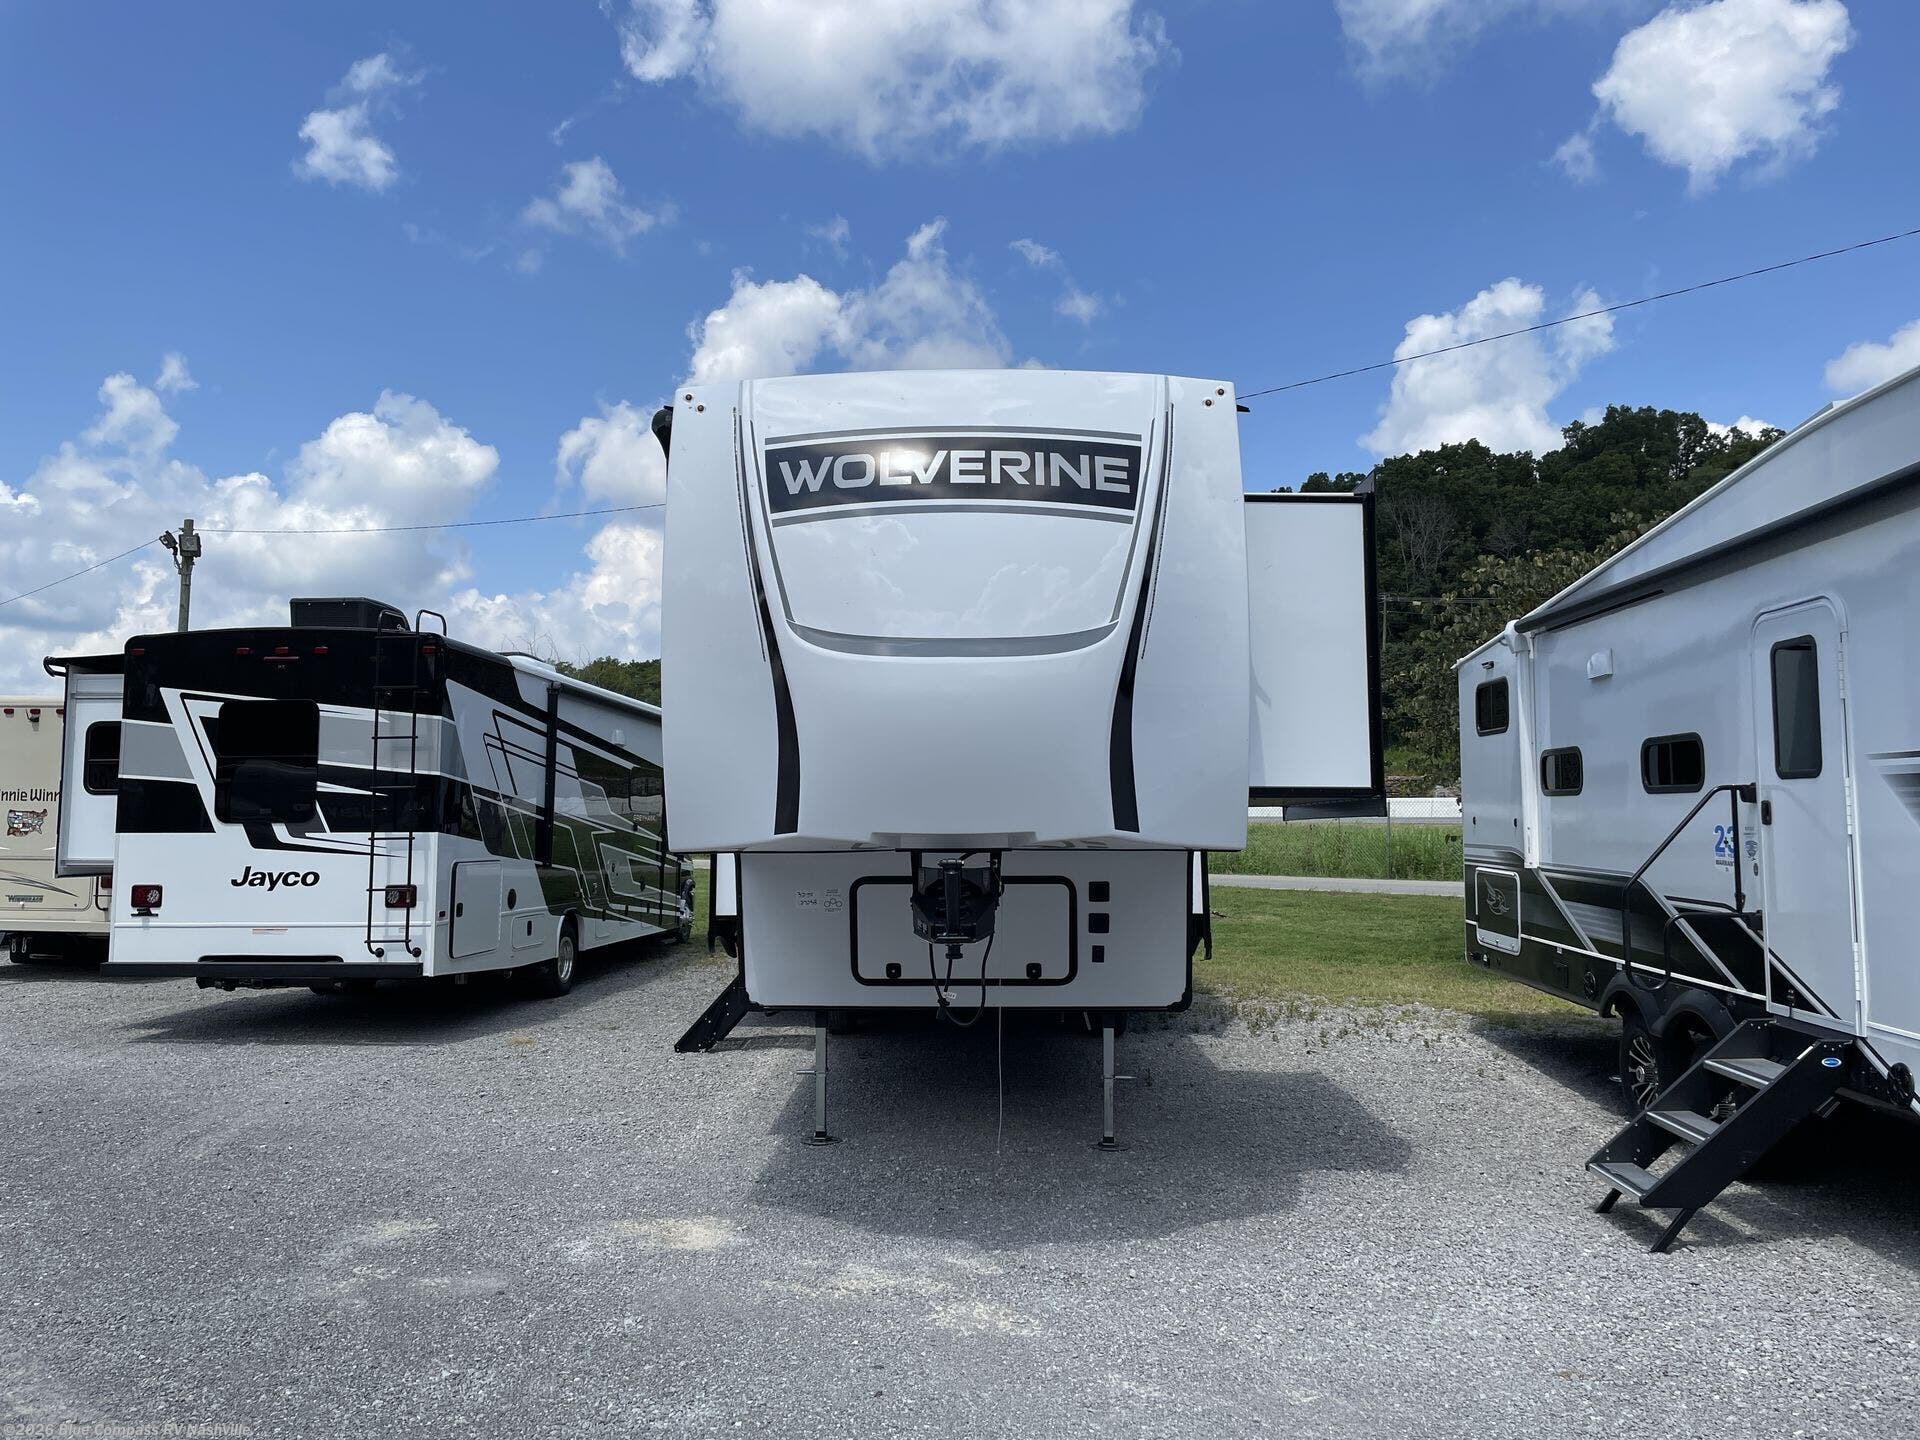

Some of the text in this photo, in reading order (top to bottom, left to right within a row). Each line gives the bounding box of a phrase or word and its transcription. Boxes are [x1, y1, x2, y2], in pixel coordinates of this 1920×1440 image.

[779, 450, 1130, 495] WOLVERINE
[0, 789, 28, 802] nnie
[230, 866, 320, 892] Jayco
